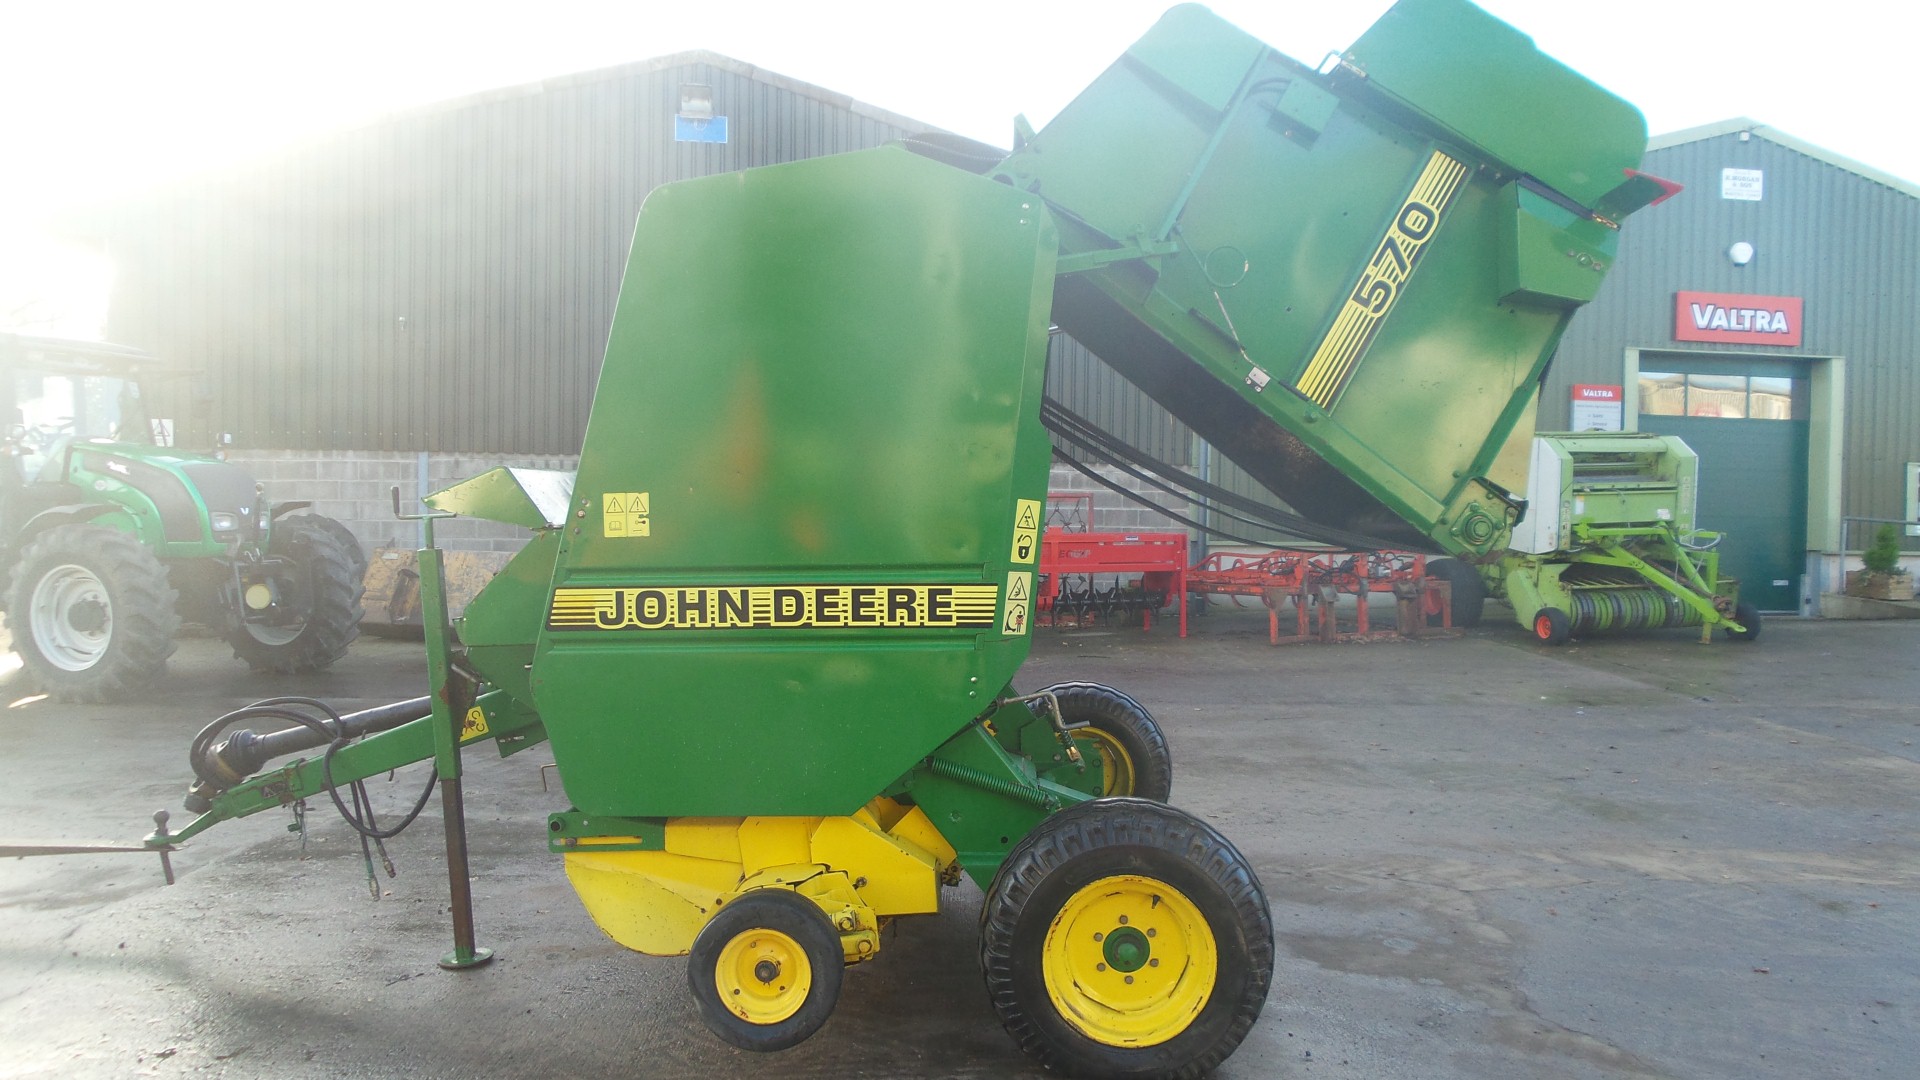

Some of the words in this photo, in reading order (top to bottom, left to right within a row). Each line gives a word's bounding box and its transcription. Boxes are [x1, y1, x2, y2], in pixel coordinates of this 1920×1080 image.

[1352, 199, 1440, 318] 570
[1690, 303, 1790, 334] VALTRA
[1583, 388, 1613, 398] VALTRA
[595, 588, 752, 629] JOHN
[772, 587, 957, 628] DEERE
